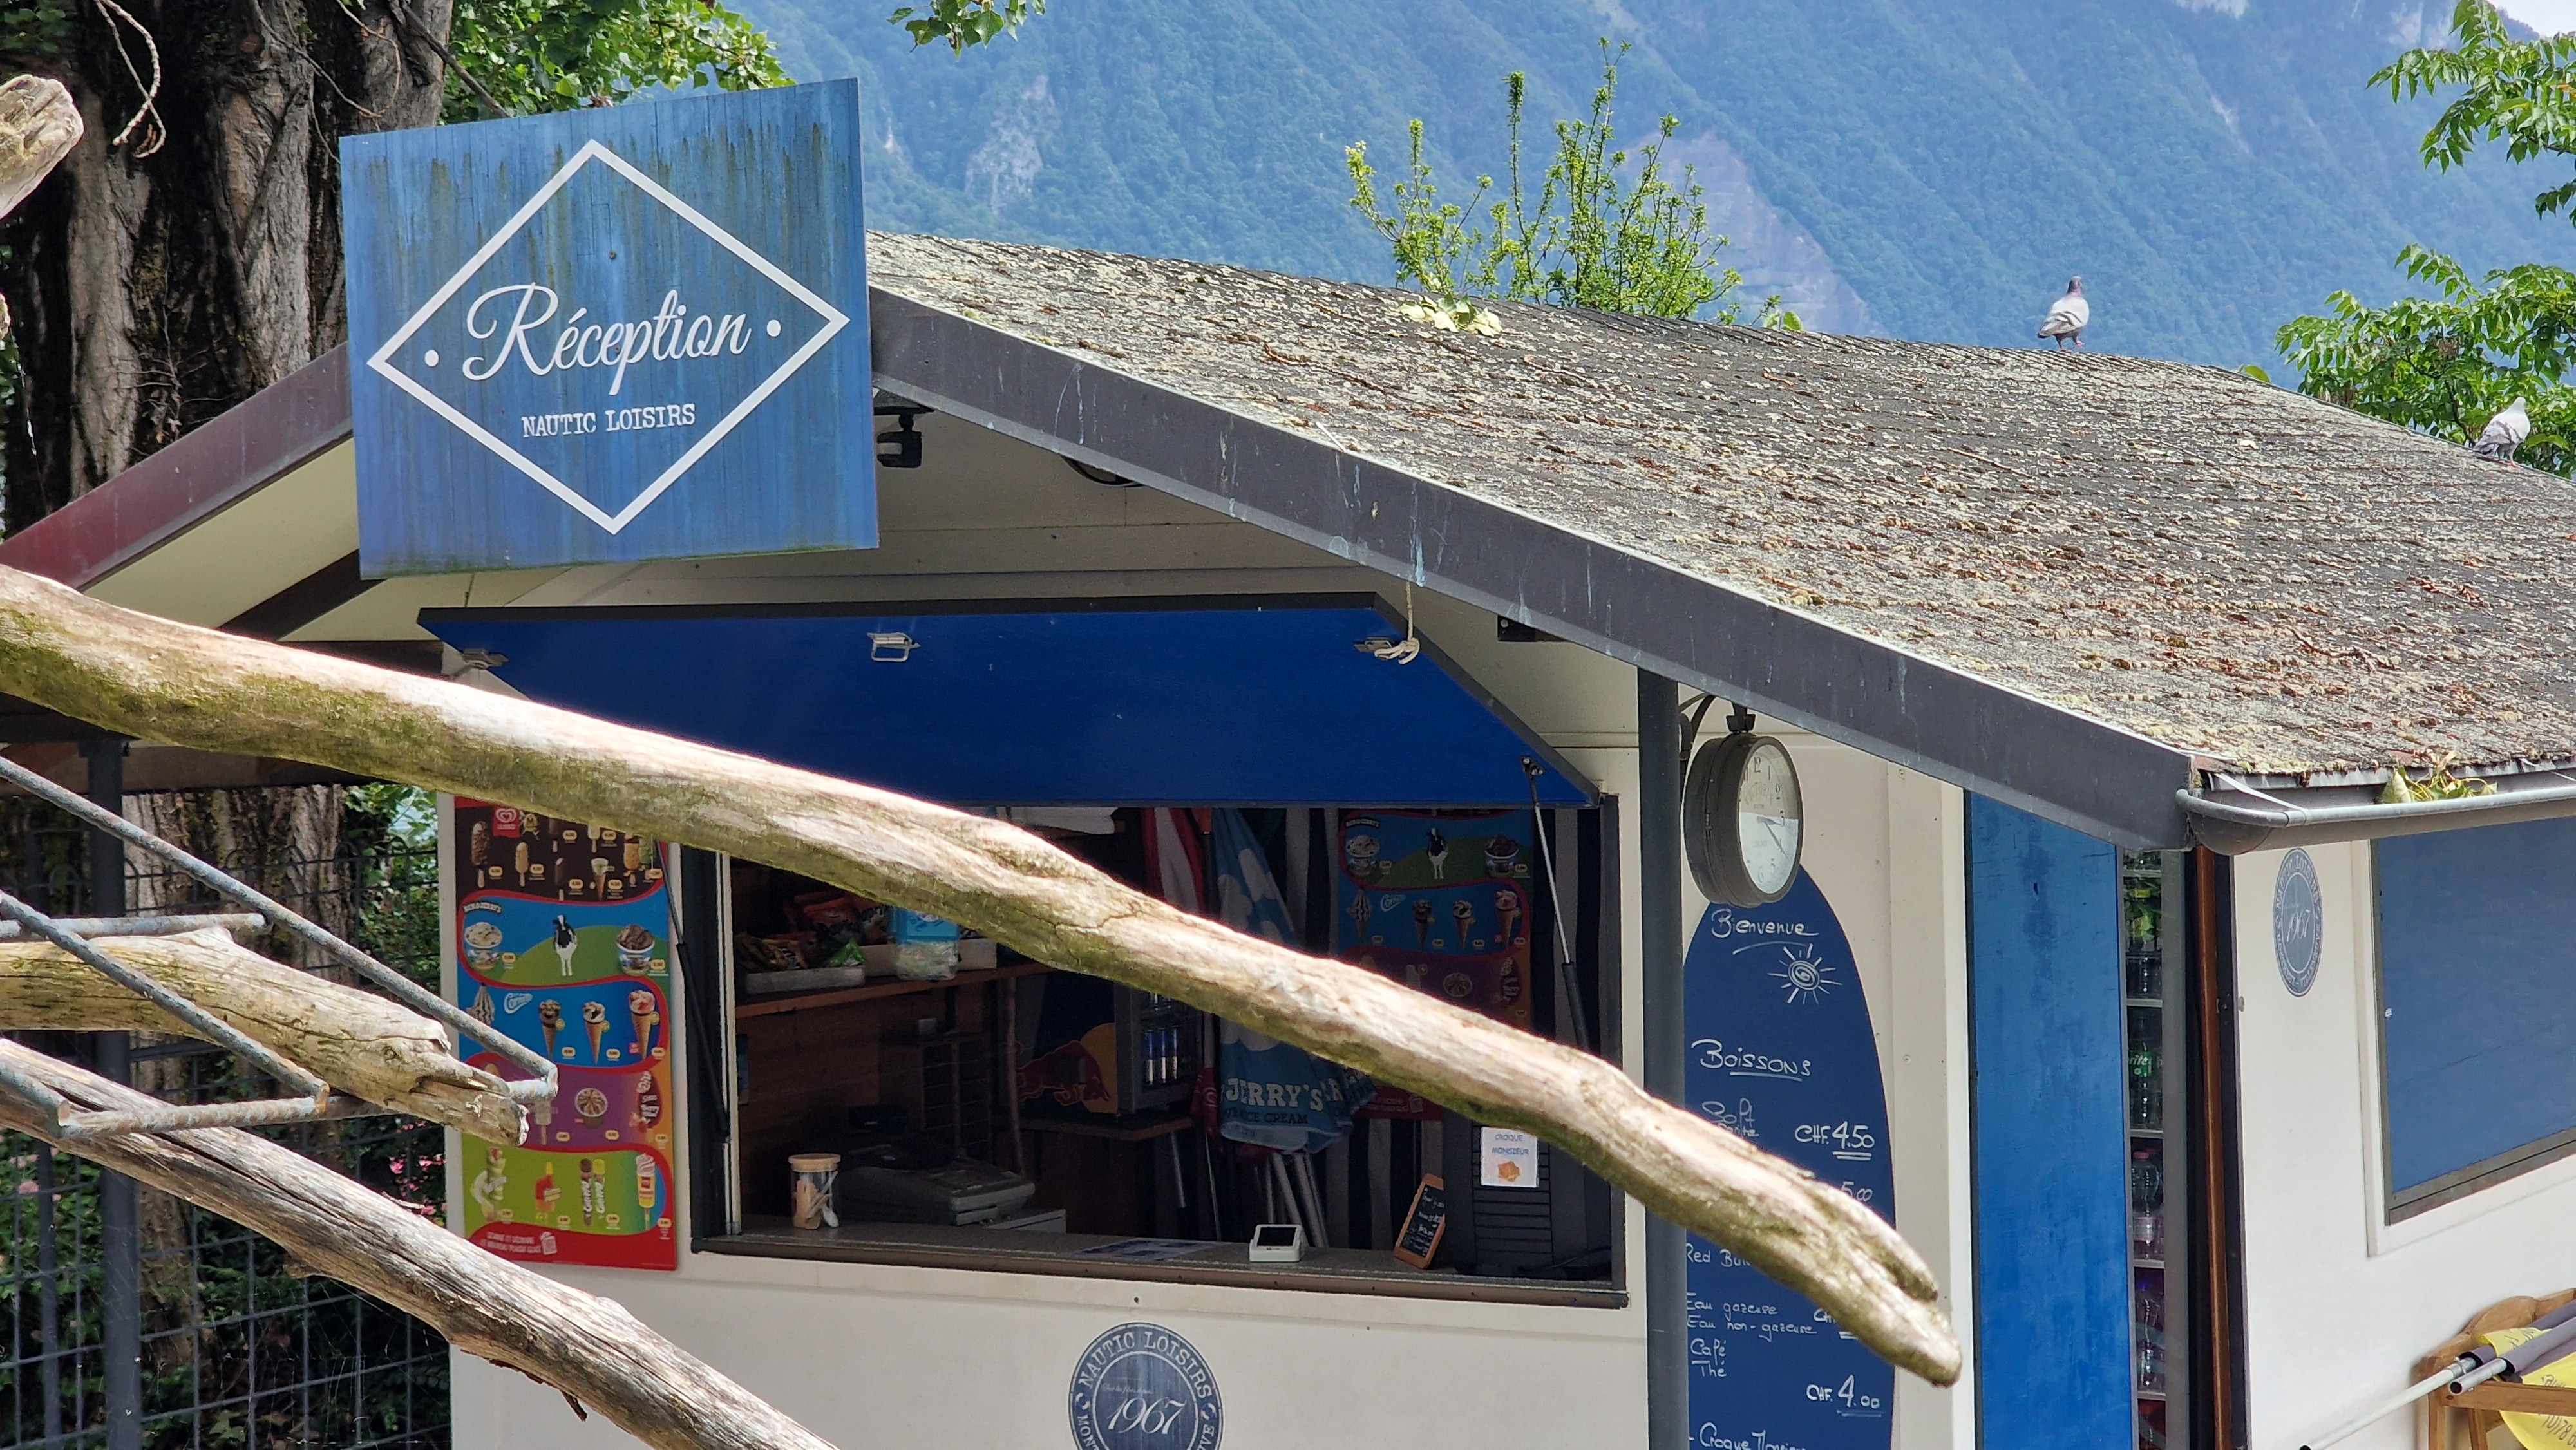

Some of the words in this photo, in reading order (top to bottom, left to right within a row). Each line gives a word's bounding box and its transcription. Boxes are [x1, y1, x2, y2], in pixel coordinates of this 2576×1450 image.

[462, 282, 752, 395] Réception
[522, 412, 597, 438] NAUTIC
[605, 403, 696, 433] LOISIRS
[1711, 909, 1819, 939] Bienvenue
[1264, 1112, 1309, 1124] CREAM
[1495, 1133, 1524, 1142] CROQUE
[1832, 1120, 1875, 1149] 4.50
[1492, 1147, 1530, 1155] MONSIEUR
[1685, 1242, 1711, 1263] Red
[1723, 1303, 1779, 1322] gazeuse
[1079, 1332, 1135, 1389] NAUTIC
[1144, 1331, 1213, 1398] LOISIRS
[1690, 1337, 1727, 1366] Café
[1691, 1359, 1727, 1377] Thé
[1837, 1374, 1880, 1409] 4.00
[1106, 1397, 1188, 1435] 1967
